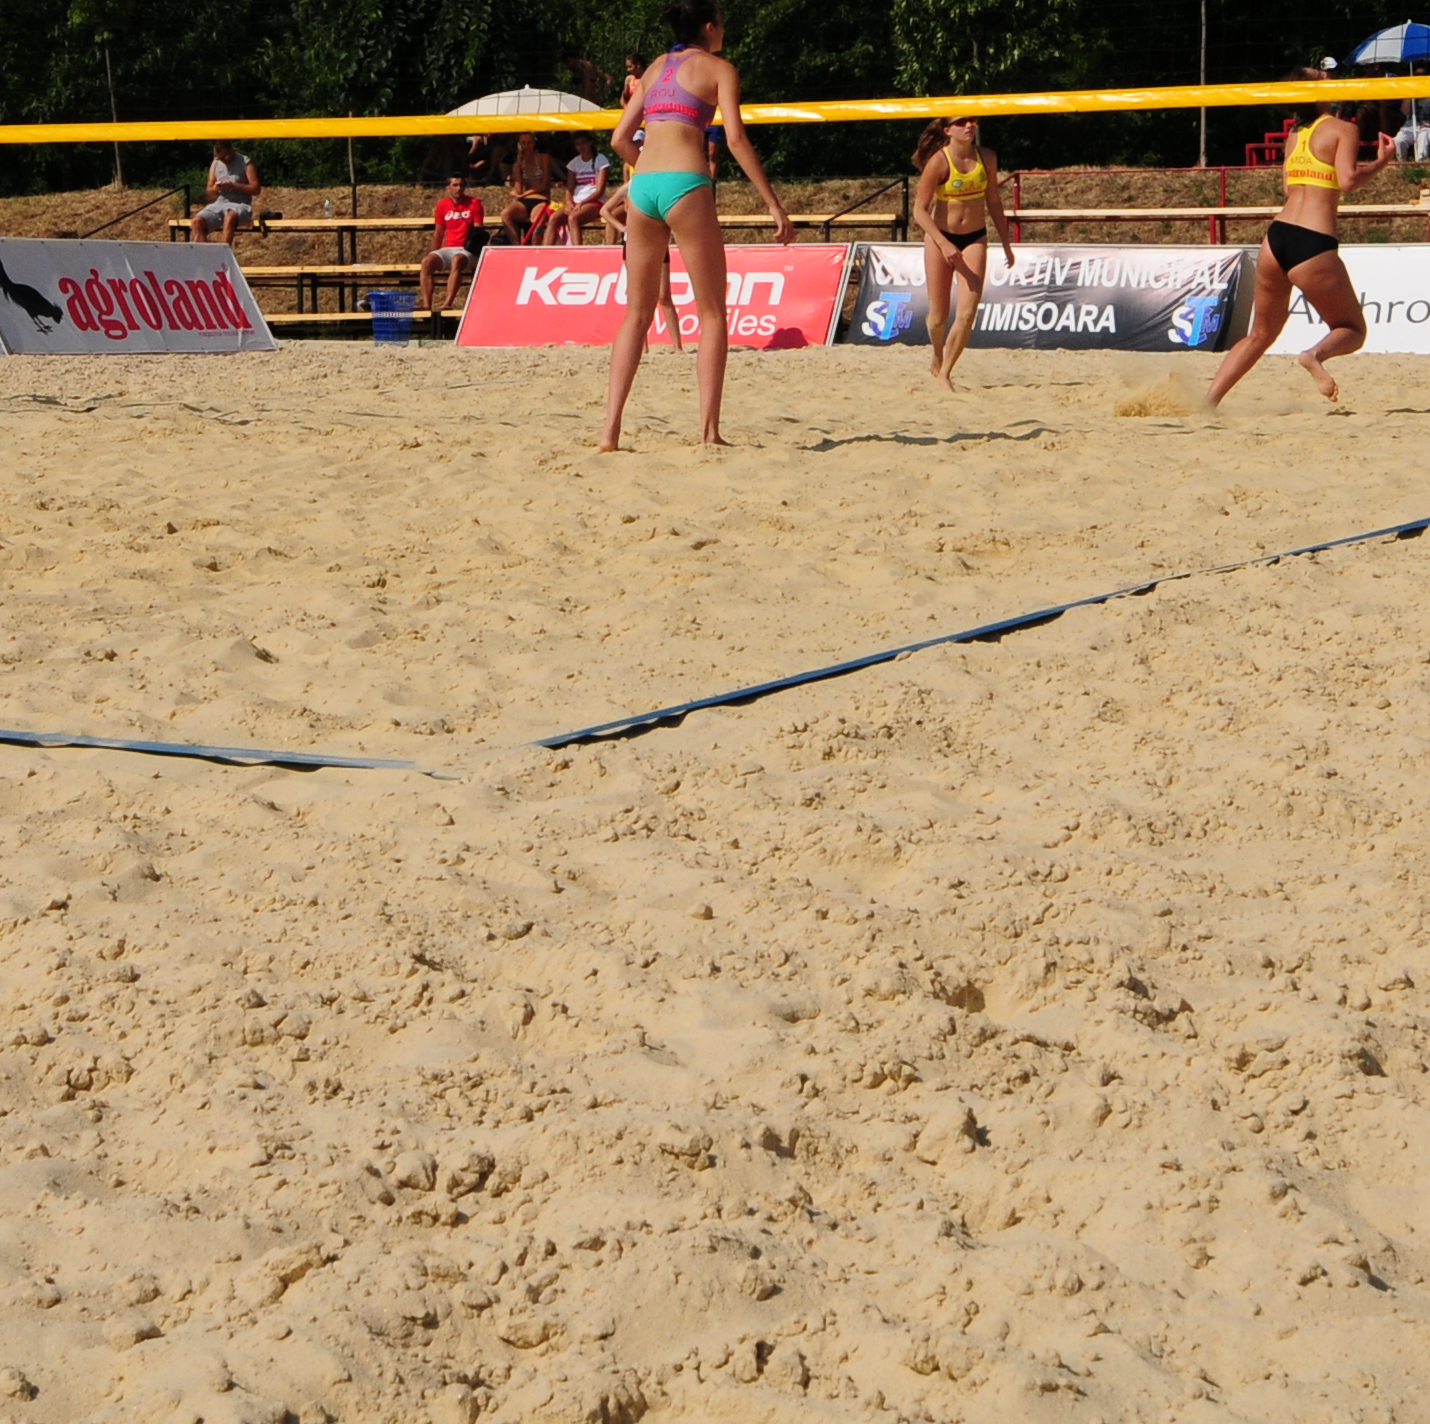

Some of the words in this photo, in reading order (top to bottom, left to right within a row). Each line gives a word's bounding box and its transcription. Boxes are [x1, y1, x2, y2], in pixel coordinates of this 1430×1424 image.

[662, 68, 674, 83] 2
[1301, 139, 1307, 152] 1
[876, 257, 925, 287] CLU
[1081, 258, 1228, 290] MUNICIPAL
[58, 268, 253, 340] agroland
[972, 302, 1116, 334] TIMISOARA
